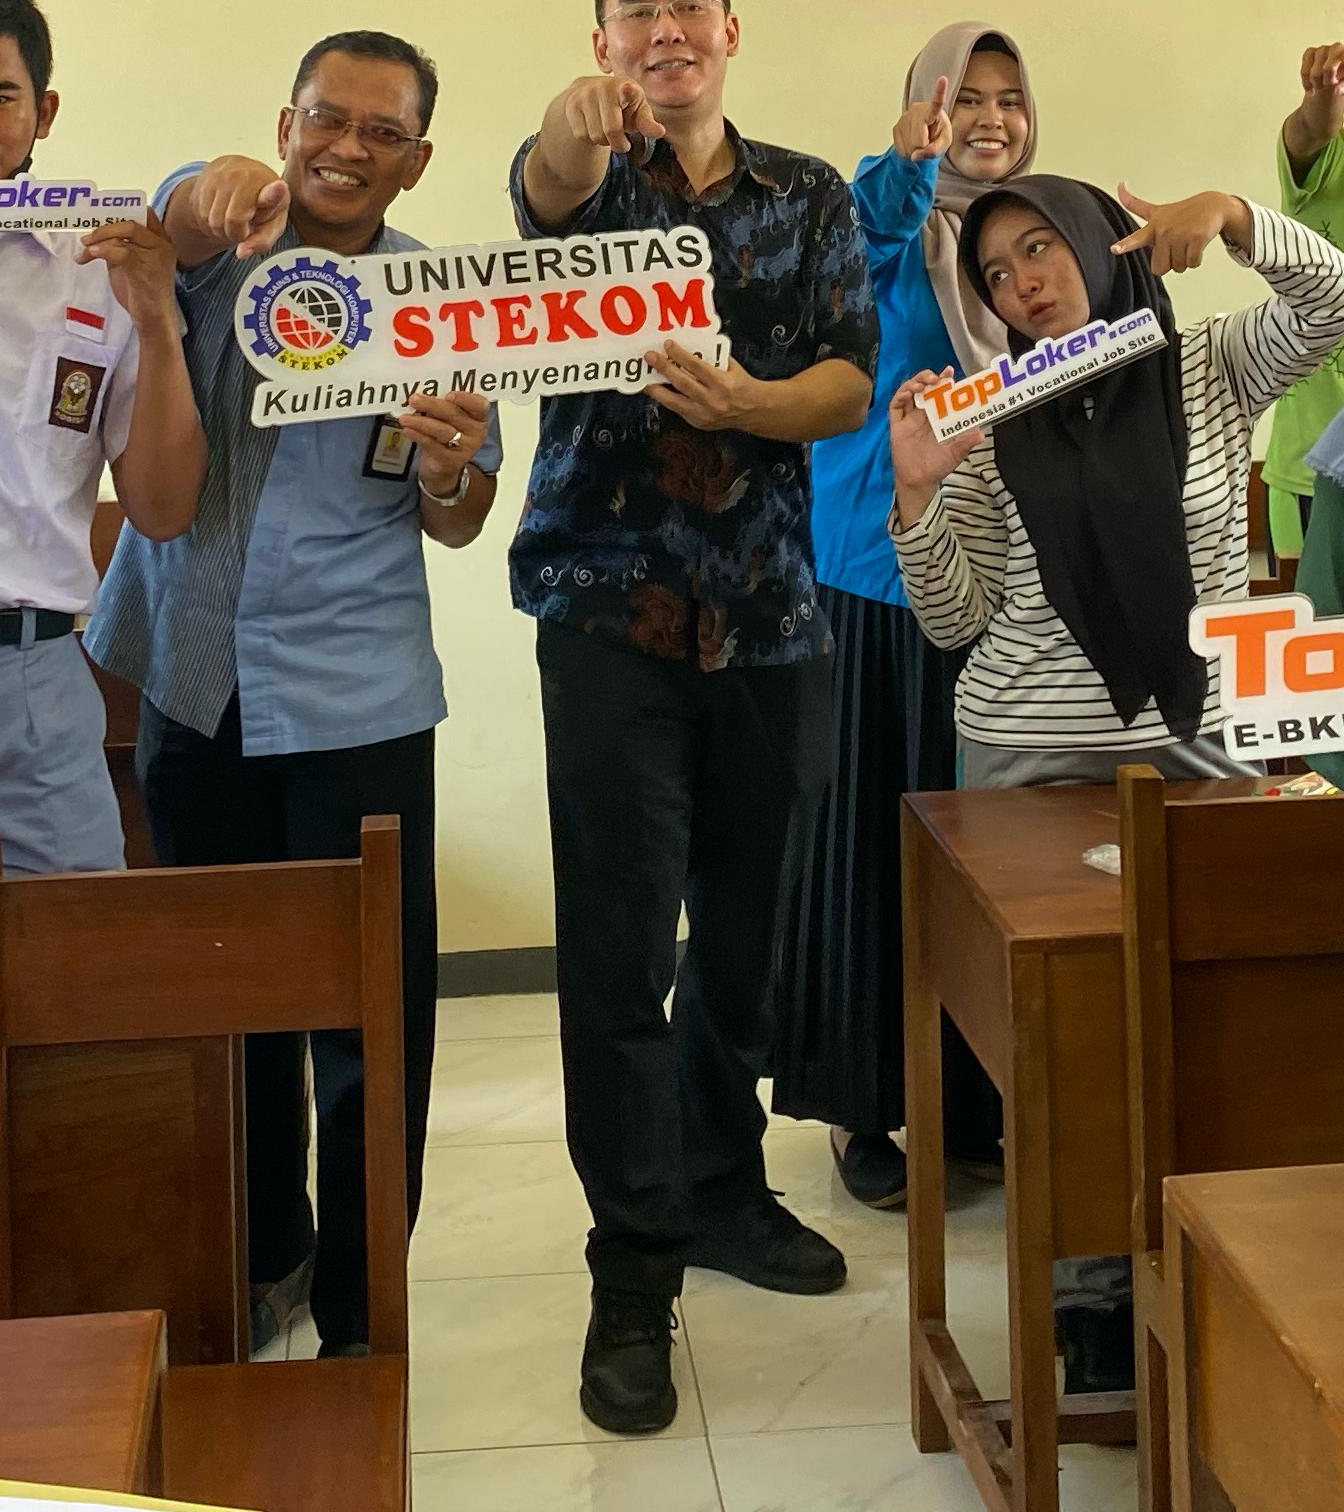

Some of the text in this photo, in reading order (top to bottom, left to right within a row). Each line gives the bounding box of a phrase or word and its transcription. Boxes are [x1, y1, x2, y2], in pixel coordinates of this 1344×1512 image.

[72, 217, 100, 228] Job
[267, 275, 292, 298] SAINS
[300, 270, 349, 296] TEKNOLOGI
[384, 235, 704, 296] UNIVERSITAS
[258, 296, 278, 353] UNIVERSITAS
[345, 293, 360, 344] KOMPUTER
[392, 279, 712, 357] STEKOM
[263, 379, 439, 416] Kuliahnya
[451, 351, 703, 394] Menyenang
[278, 349, 348, 370] STEKOM
[923, 312, 1153, 419] TopLoker.com
[940, 332, 1156, 438] Indonesia #1 Vocational Job Site
